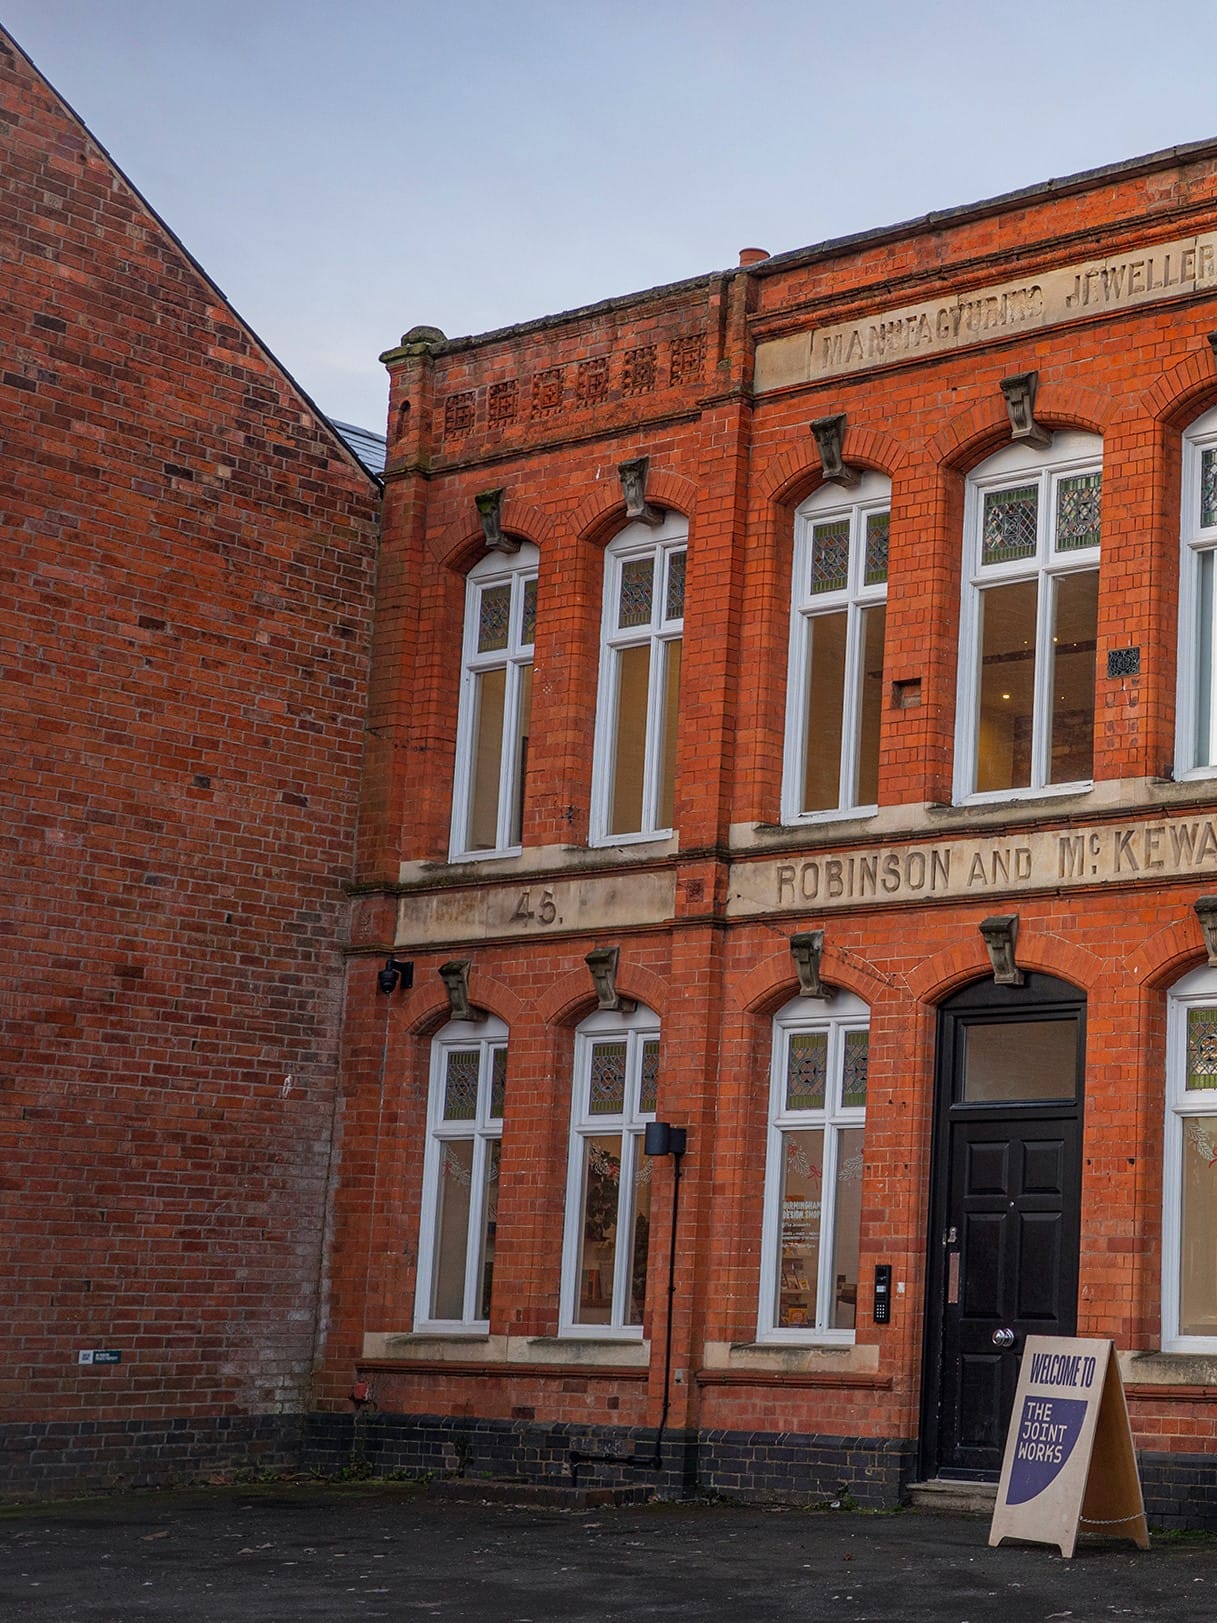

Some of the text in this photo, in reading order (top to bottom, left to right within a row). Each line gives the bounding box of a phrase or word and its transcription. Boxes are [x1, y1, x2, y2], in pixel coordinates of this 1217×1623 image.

[776, 849, 951, 904] ROBINSON
[966, 847, 1033, 887] AND
[509, 888, 564, 928] 45.
[1030, 1353, 1096, 1388] WELCOME TO
[1027, 1402, 1053, 1421] THE
[1022, 1421, 1068, 1443] JOINT
[1018, 1441, 1063, 1463] WORKS
